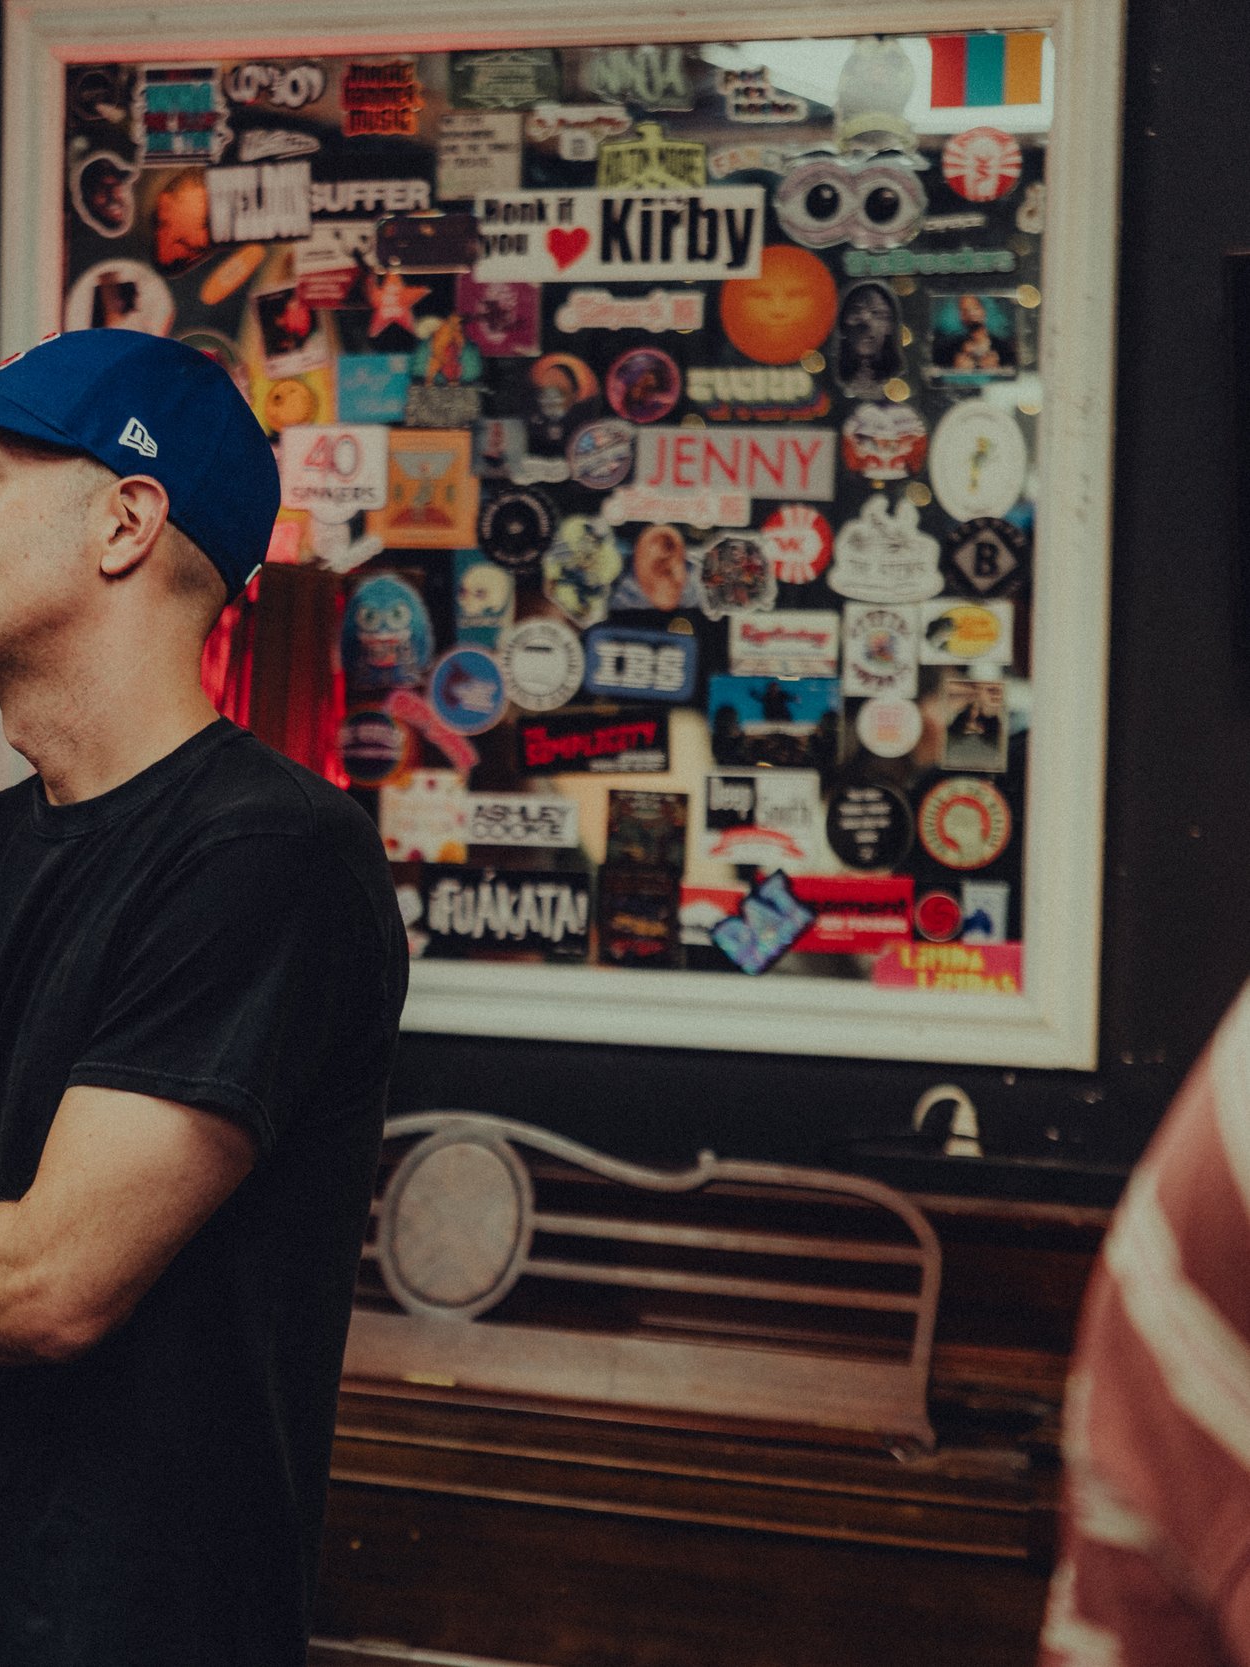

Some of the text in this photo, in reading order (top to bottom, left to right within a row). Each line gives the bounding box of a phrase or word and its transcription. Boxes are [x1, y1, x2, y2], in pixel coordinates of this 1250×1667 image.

[601, 198, 755, 270] Kirby
[303, 433, 363, 484] 40
[645, 435, 823, 490] JENNY
